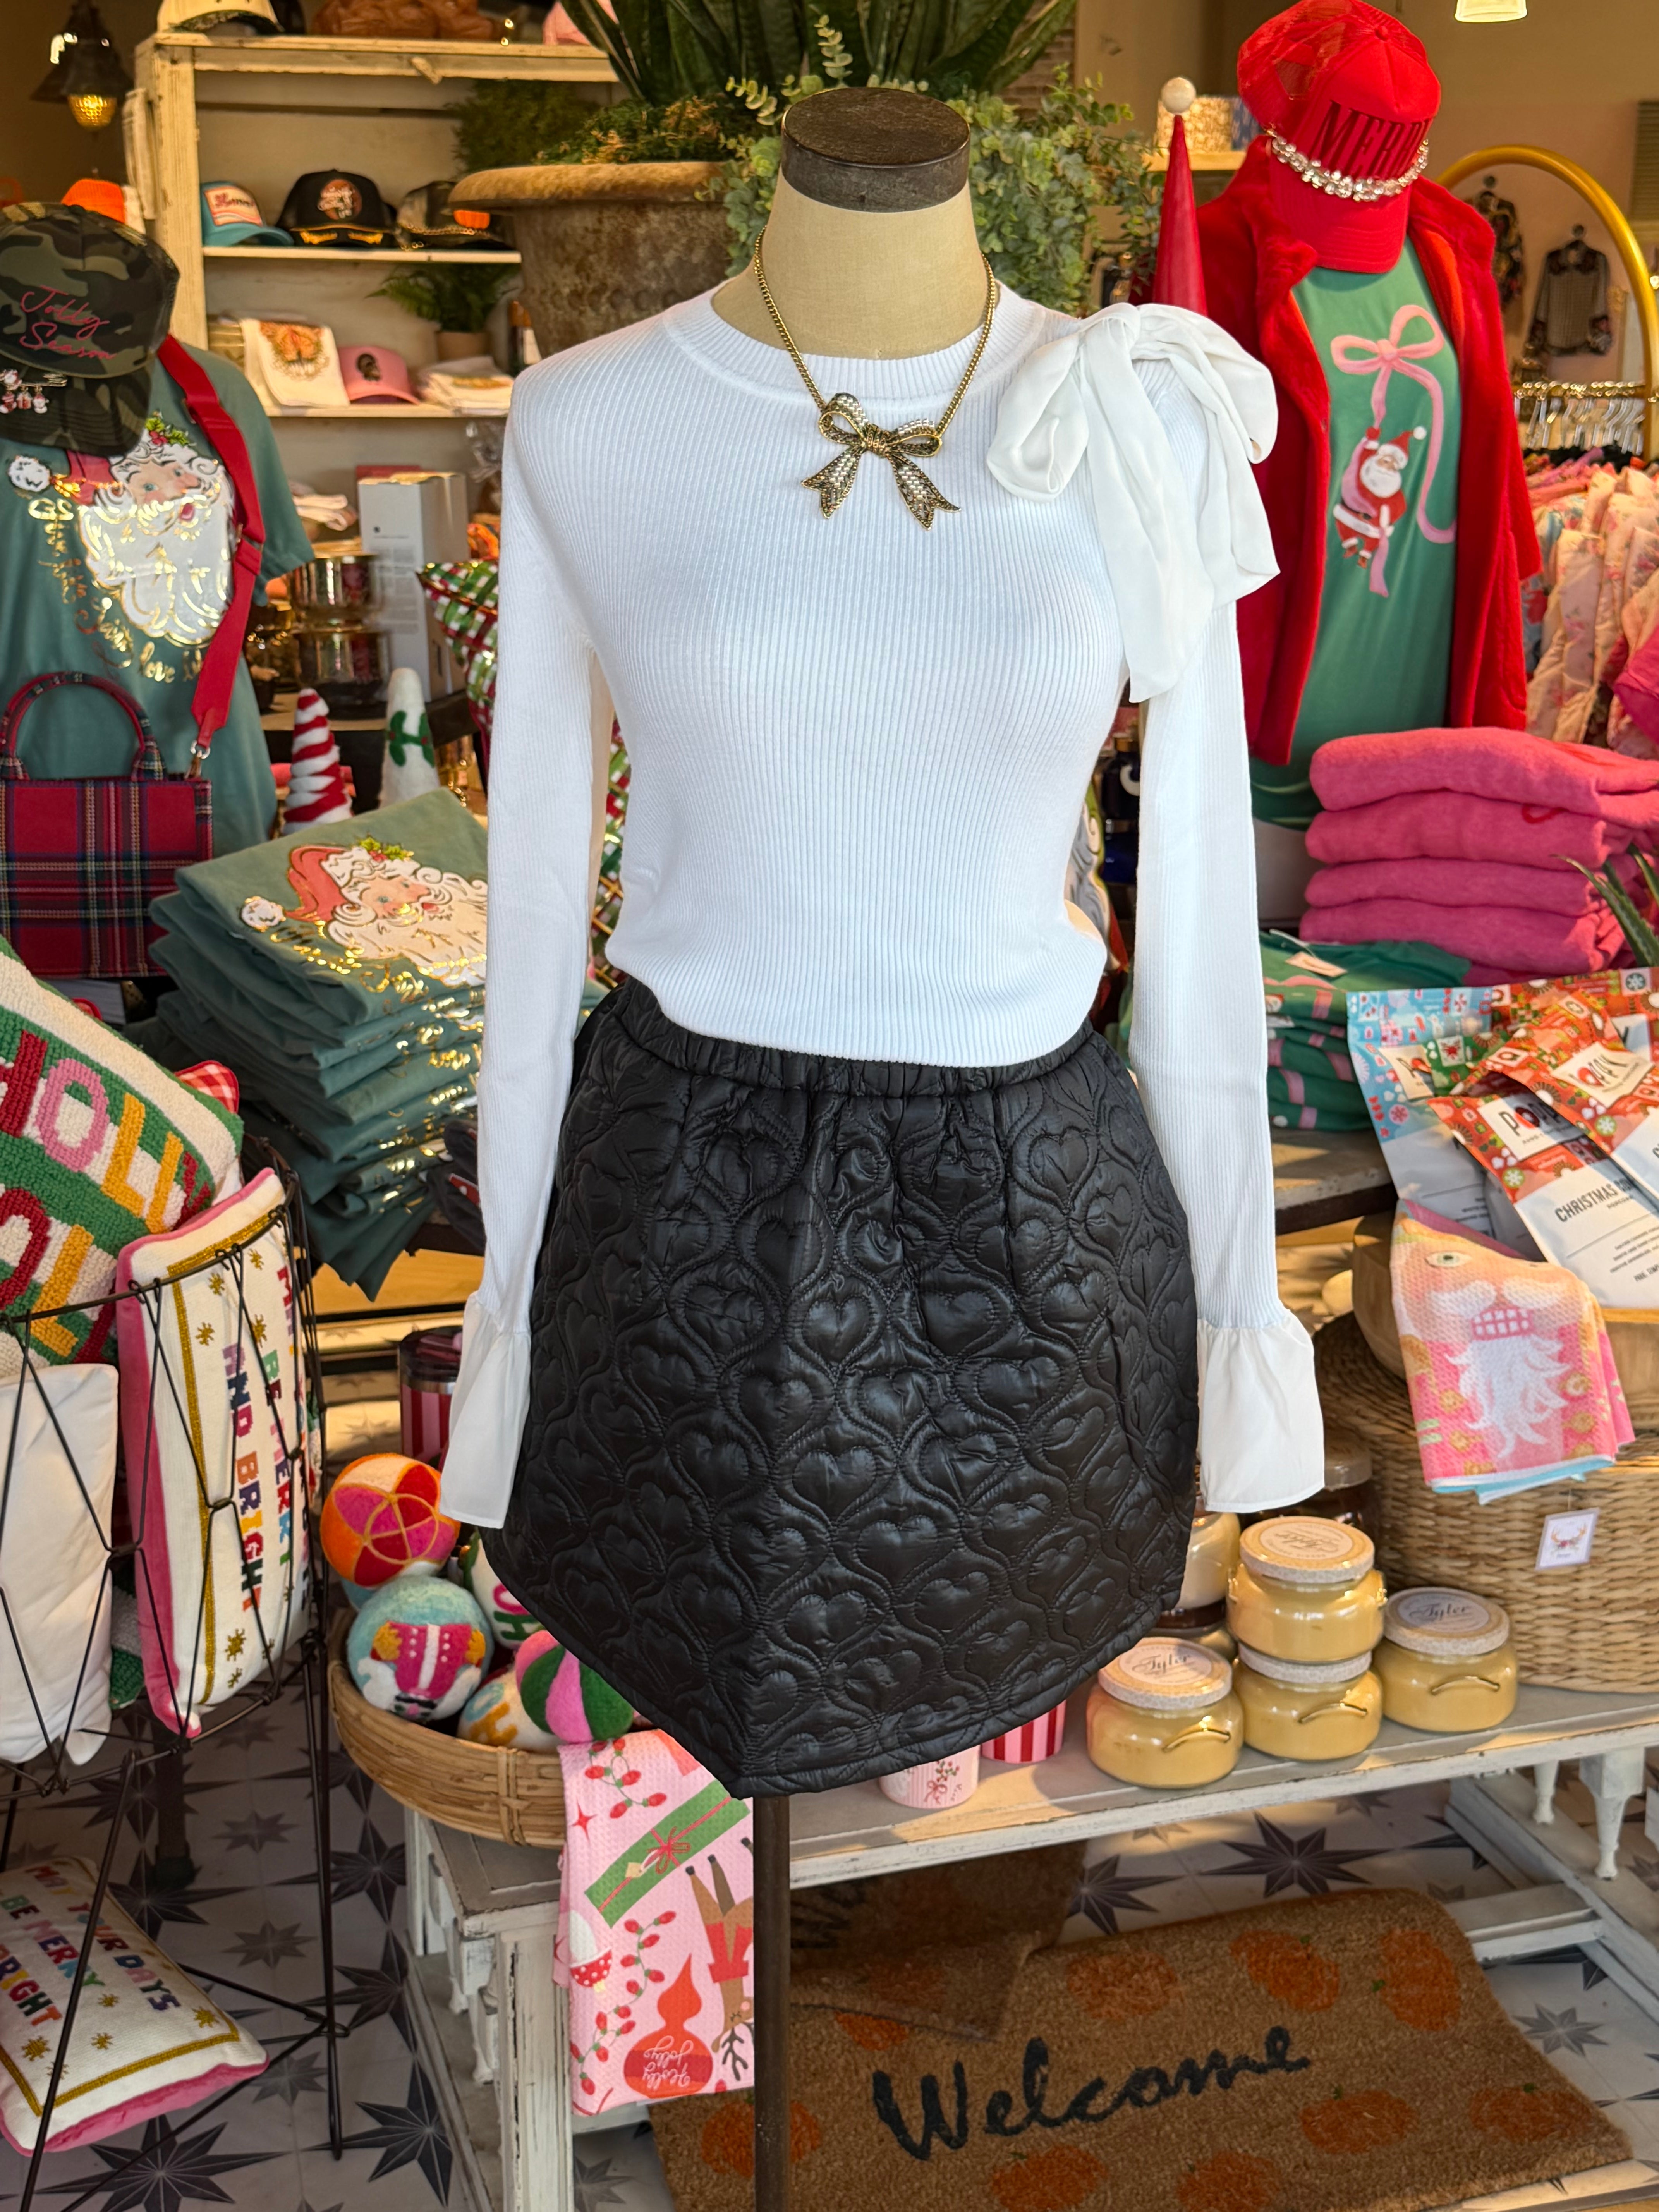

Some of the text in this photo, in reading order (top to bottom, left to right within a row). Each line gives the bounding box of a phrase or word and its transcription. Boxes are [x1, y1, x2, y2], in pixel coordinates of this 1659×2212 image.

[20, 284, 110, 341] Jolly
[1554, 1183, 1618, 1223] CHRISTMAS
[222, 1343, 264, 1612] AND BRIGHT
[1408, 1602, 1468, 1621] Tyler
[0, 1894, 106, 1987] BE MERRY
[113, 1953, 182, 2011] DAYS
[871, 2025, 1311, 2161] Welcome
